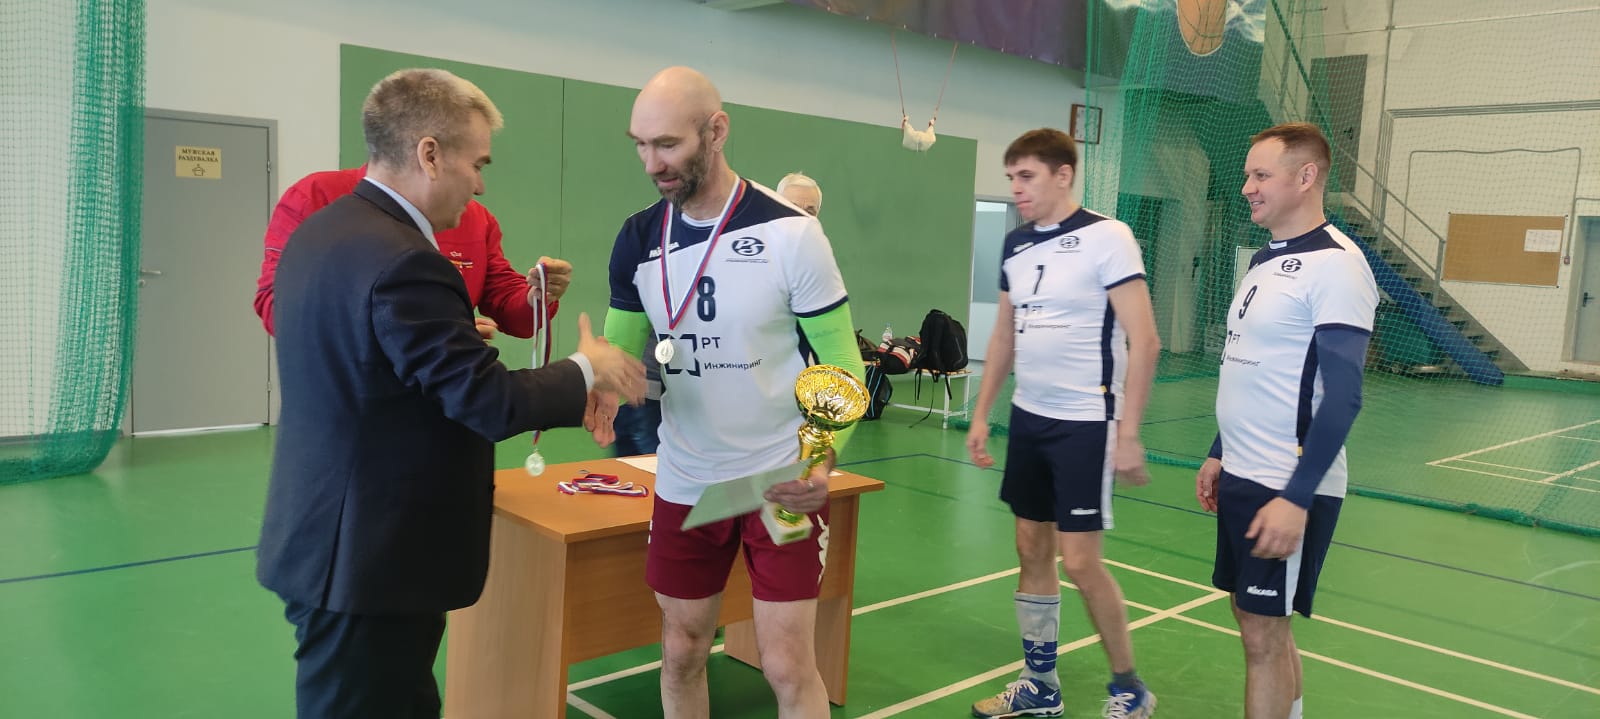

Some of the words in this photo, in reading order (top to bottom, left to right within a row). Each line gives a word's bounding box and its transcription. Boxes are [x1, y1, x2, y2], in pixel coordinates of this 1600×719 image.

[181, 148, 215, 156] МУЖСКАЯ
[1032, 264, 1046, 296] 7
[696, 275, 717, 322] 8
[1238, 284, 1258, 320] 9
[703, 358, 763, 371] Инжиниринг
